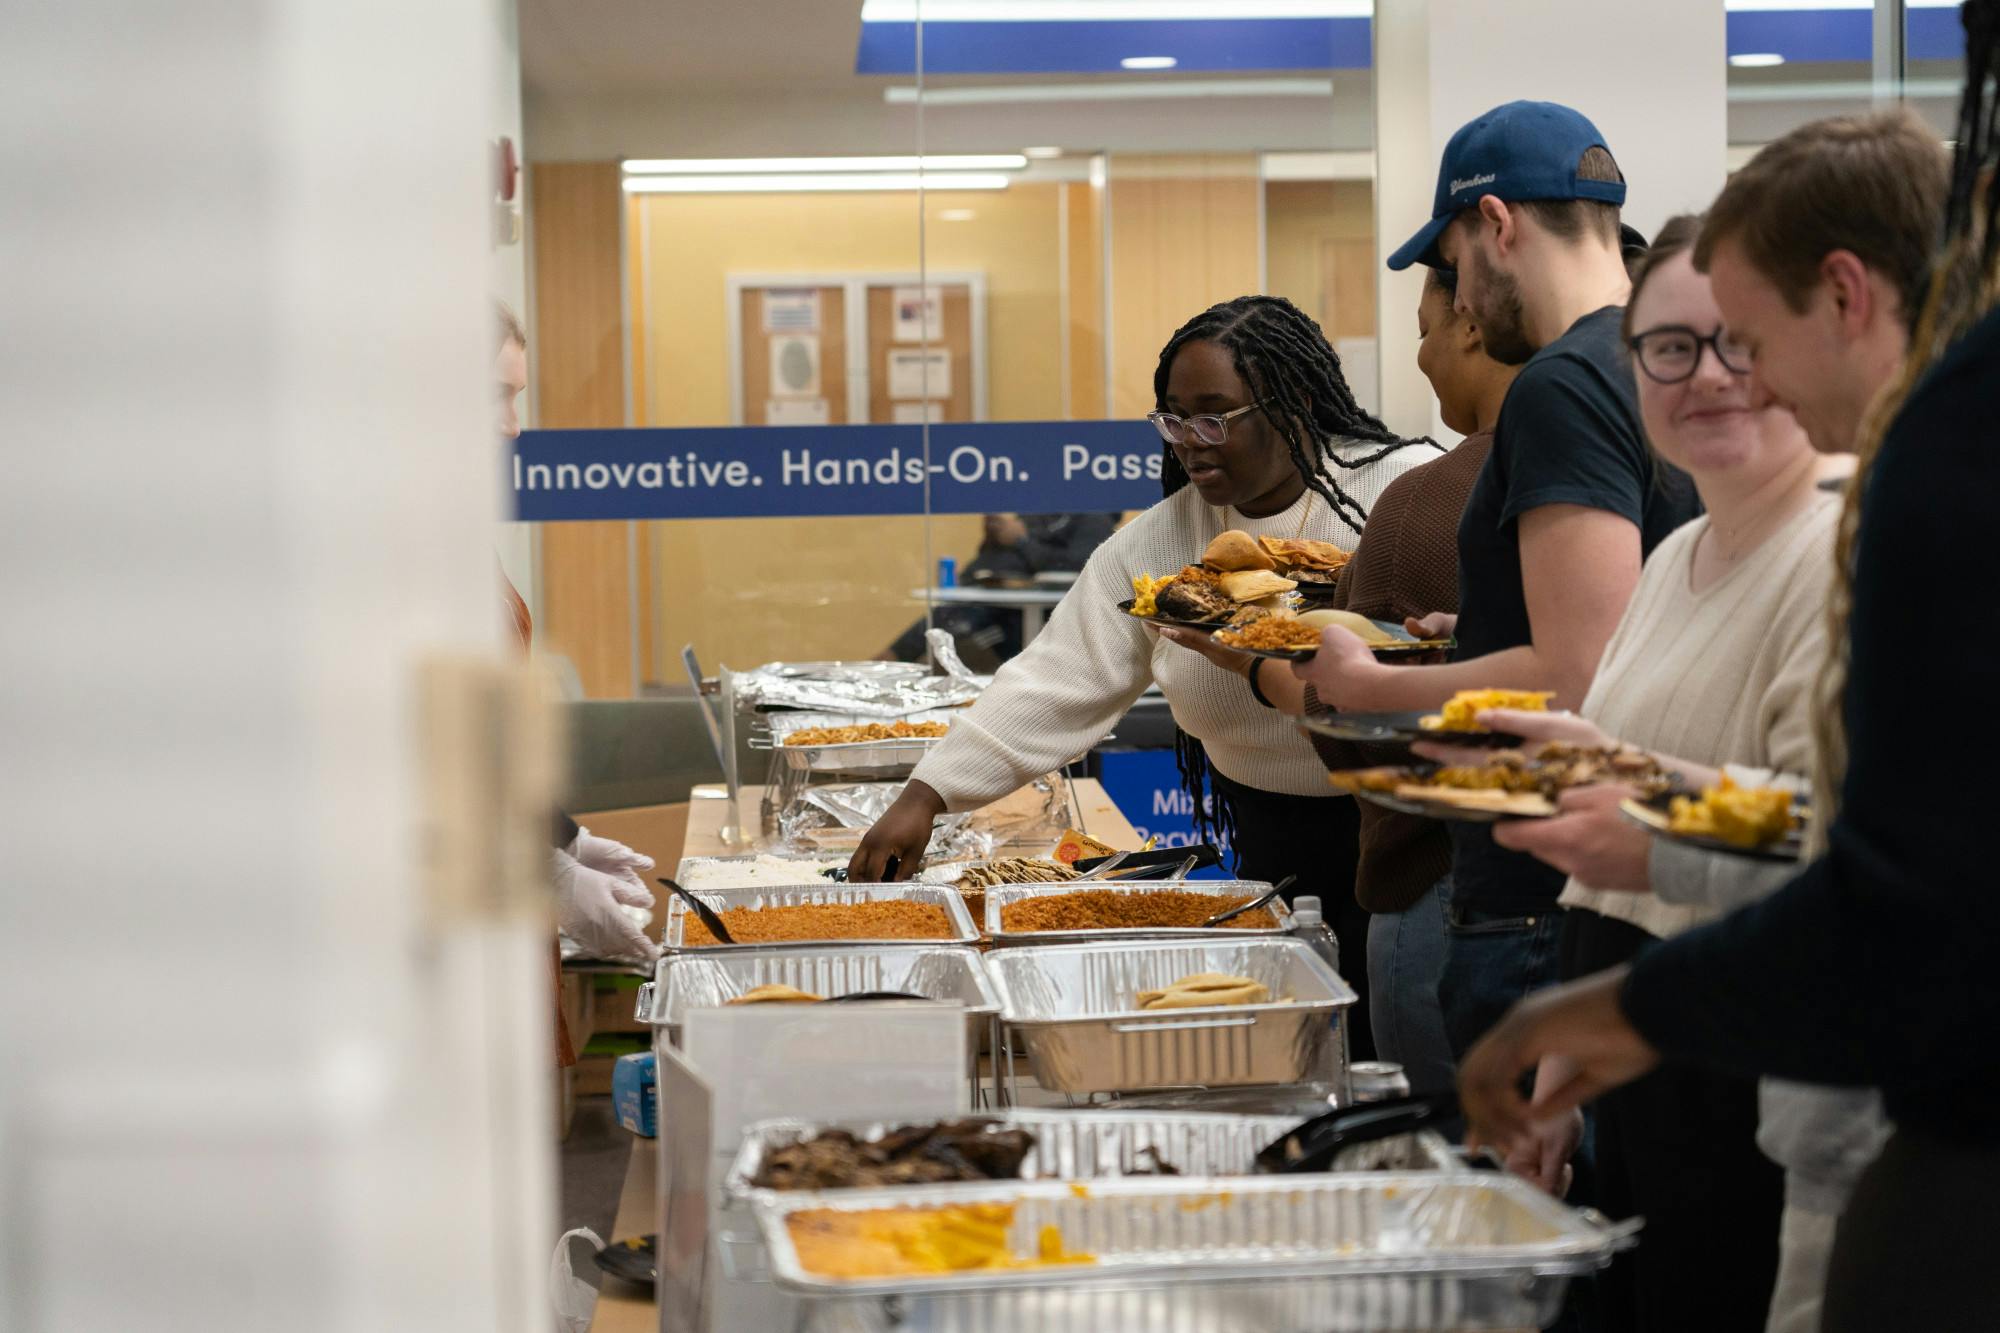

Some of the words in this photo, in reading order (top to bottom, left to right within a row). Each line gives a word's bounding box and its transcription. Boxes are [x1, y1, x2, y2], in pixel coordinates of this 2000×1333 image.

[513, 452, 763, 490] Innovative.
[782, 445, 1029, 486] Hands-On.
[1063, 444, 1163, 481] Pass
